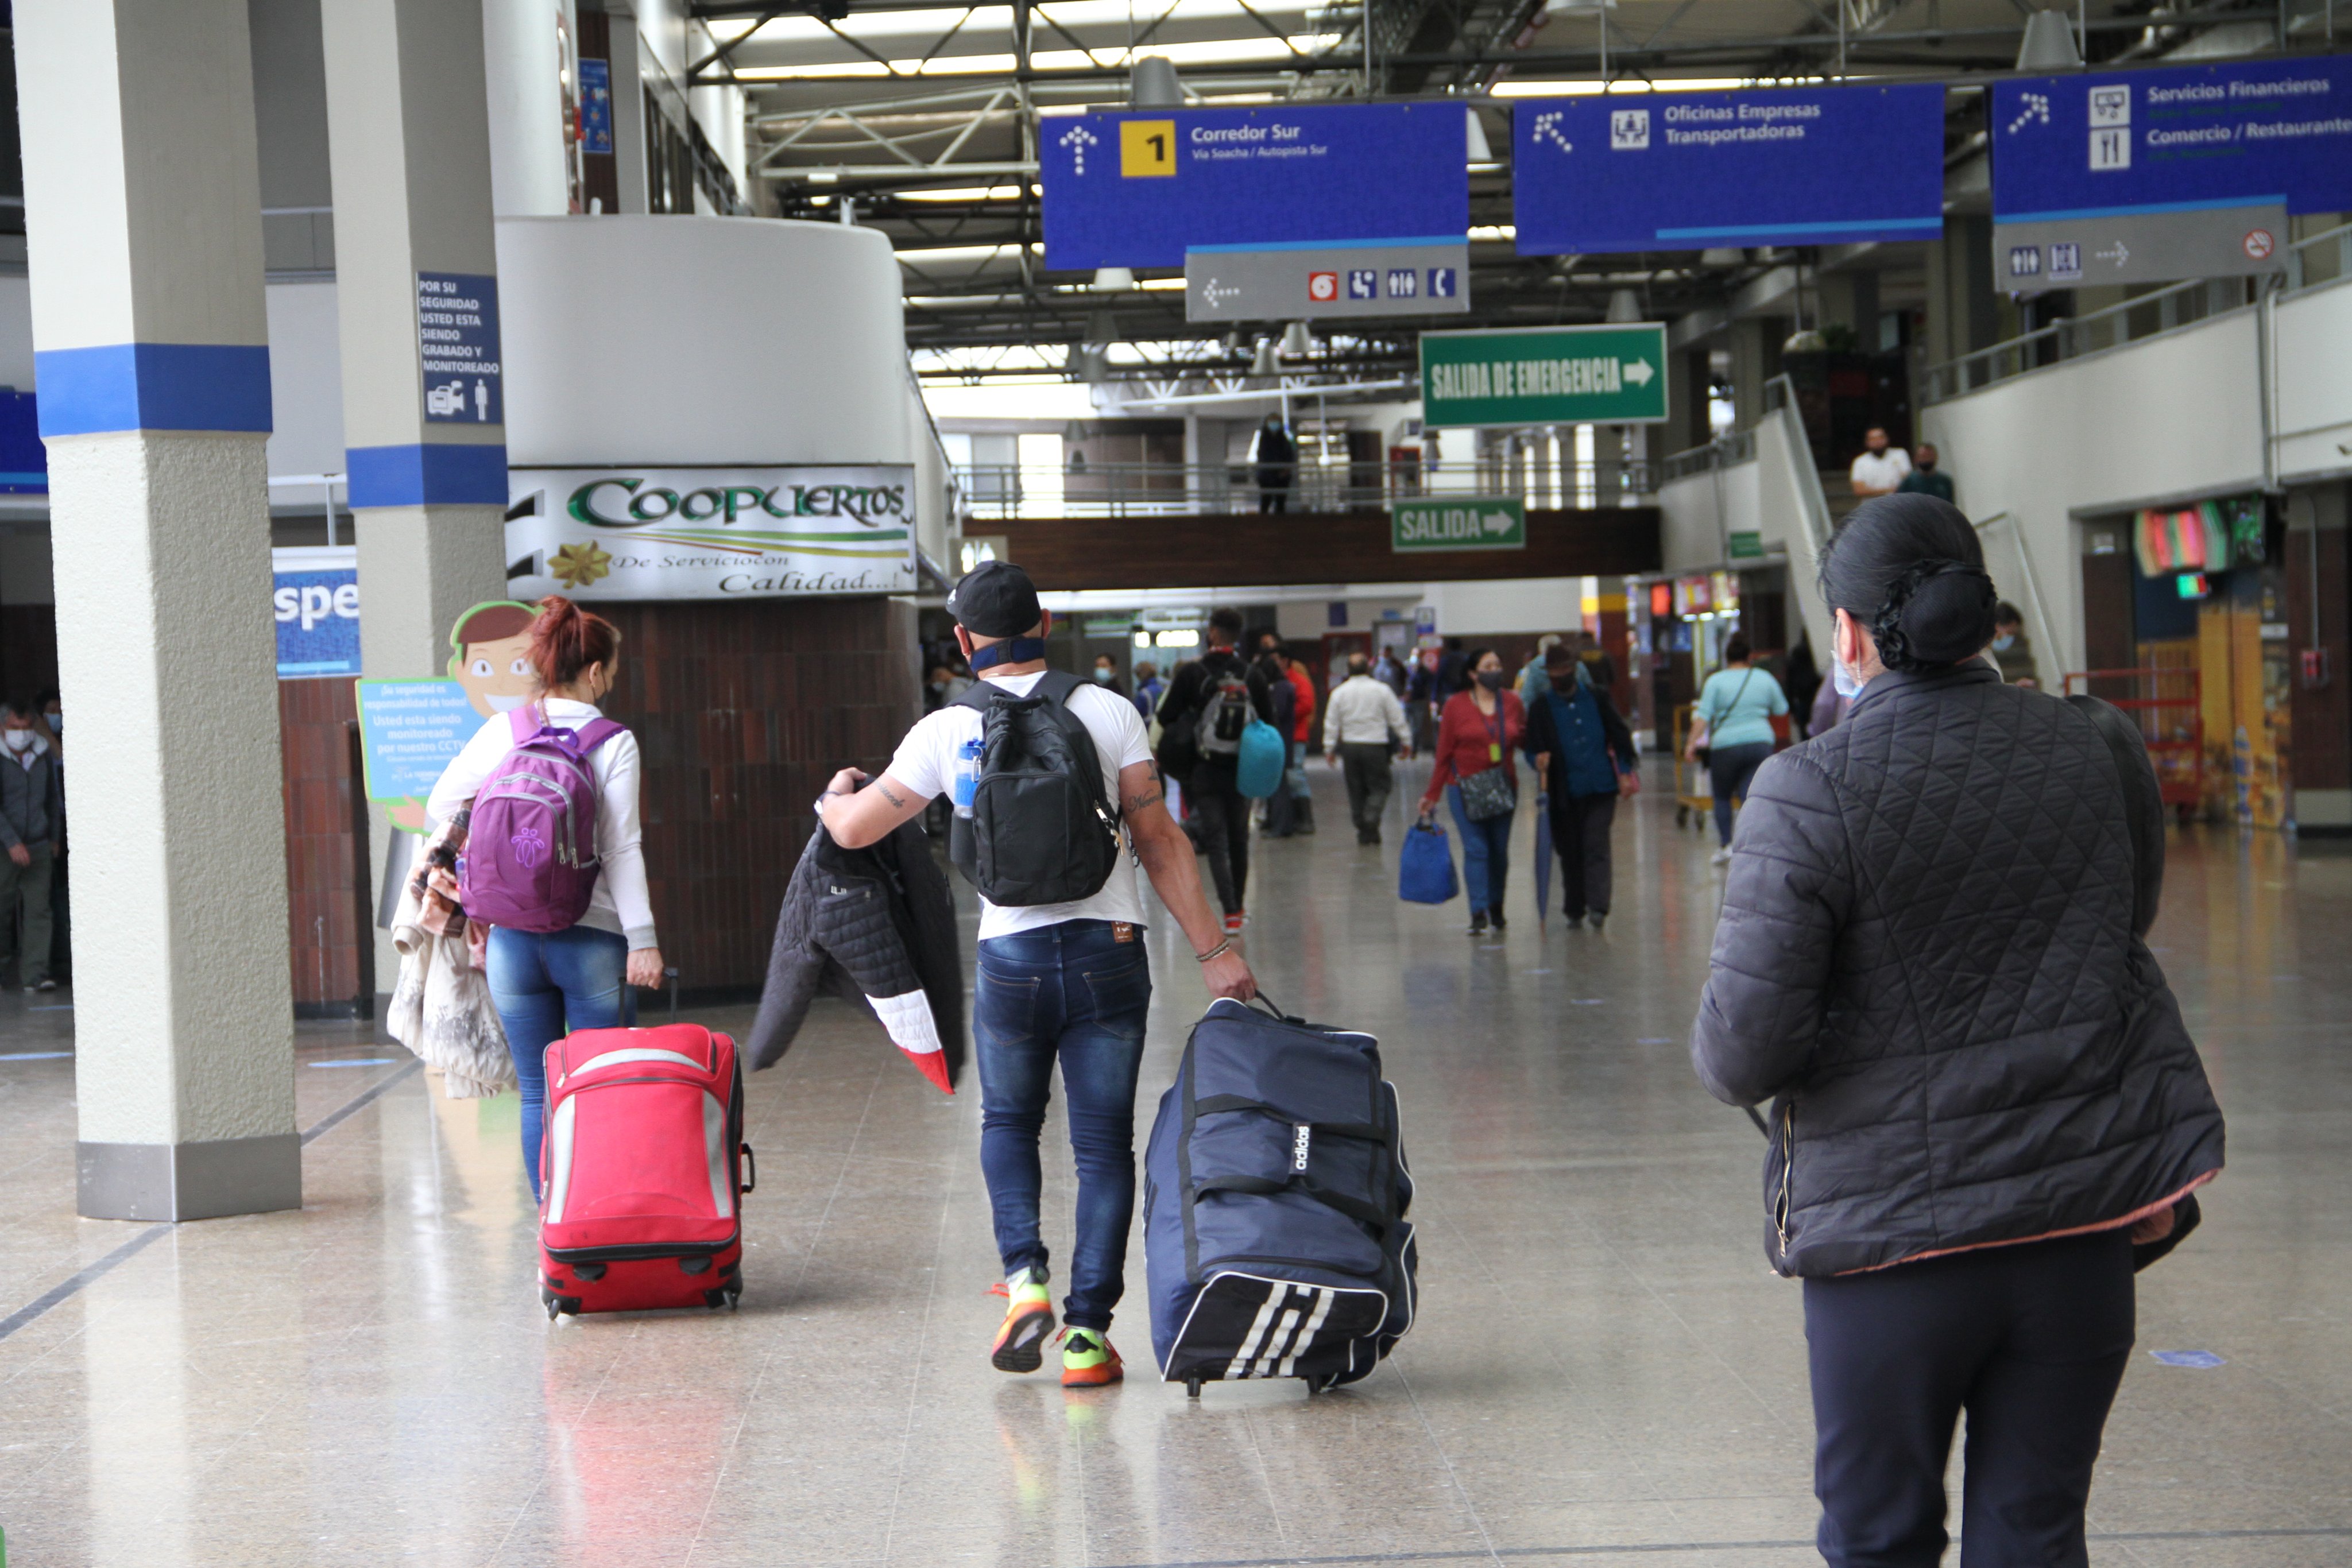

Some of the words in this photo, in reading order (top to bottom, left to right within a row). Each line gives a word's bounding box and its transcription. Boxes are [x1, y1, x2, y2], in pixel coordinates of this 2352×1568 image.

[2148, 83, 2226, 103] Servicios
[2229, 77, 2331, 99] Financieros
[1665, 104, 1734, 122] Oficinas
[1738, 103, 1821, 122] Empresas
[1191, 125, 1267, 142] Corredor
[1271, 124, 1301, 139] Sur
[1666, 123, 1805, 146] Transportadoras
[2146, 124, 2232, 146] Comercio
[1146, 133, 1164, 161] 1
[1211, 147, 1249, 160] Soacha
[1257, 145, 1307, 158] Autopista
[1310, 144, 1328, 155] Sur
[419, 280, 440, 292] POR
[443, 281, 457, 293] SU
[420, 296, 479, 310] SEGURIDAD
[420, 313, 454, 324] USTED
[456, 314, 481, 326] ESTA
[421, 328, 460, 340] SIENDO
[422, 344, 472, 357] GRABADO
[475, 346, 482, 357] Y
[423, 360, 499, 373] MONITOREADO
[1432, 362, 1491, 400] SALIDA
[1493, 361, 1514, 397] DE
[1517, 357, 1622, 396] EMERGENCIA
[1401, 509, 1481, 540] SALIDA
[612, 555, 651, 568] De
[396, 684, 435, 695] seguridad
[364, 699, 427, 710] responsabilidad
[430, 698, 440, 707] de
[373, 715, 403, 726] Usted
[405, 716, 425, 725] esta
[428, 714, 461, 724] siendo
[387, 729, 453, 739] monitoreado
[377, 745, 395, 756] por
[397, 742, 436, 753] nuestro
[1294, 1126, 1309, 1170] adidas
